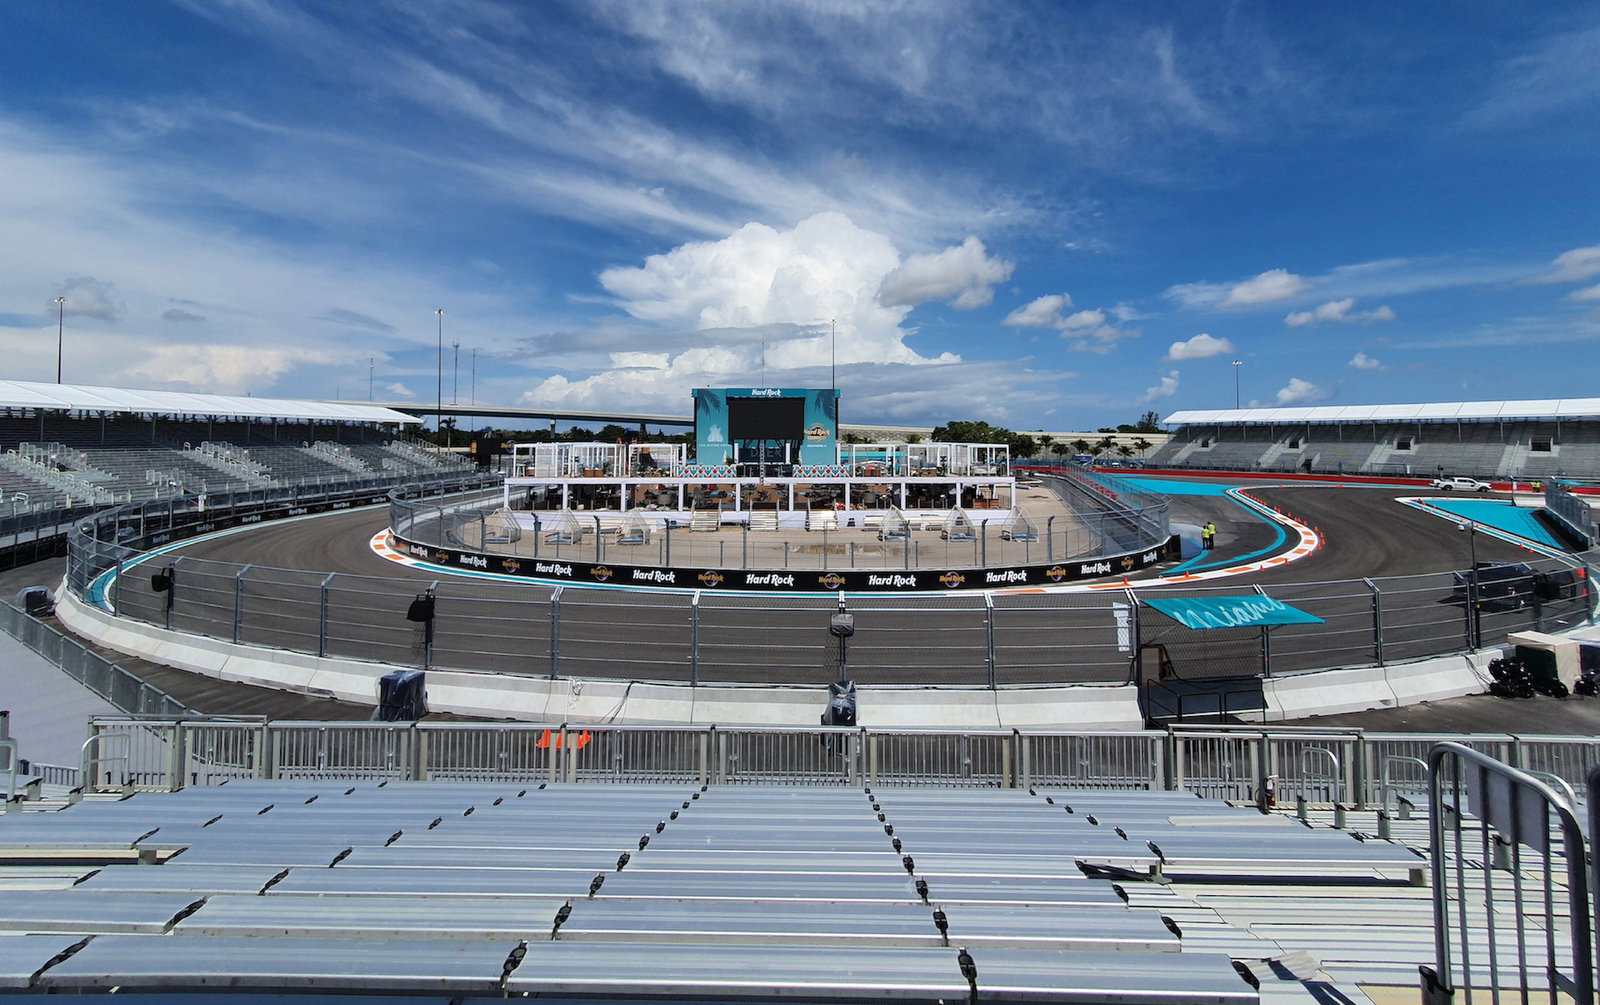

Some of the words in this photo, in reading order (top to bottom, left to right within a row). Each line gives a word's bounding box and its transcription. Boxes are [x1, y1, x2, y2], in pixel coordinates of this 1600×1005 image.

[767, 389, 781, 397] Rock
[751, 449, 782, 458] DER
[460, 555, 473, 564] Hard
[474, 556, 488, 568] Rock
[1081, 563, 1097, 574] Hard
[1097, 561, 1111, 574] Rock
[535, 563, 554, 573] Hard
[554, 564, 572, 576] Rock
[633, 569, 654, 580] Hard
[654, 570, 675, 583] Rock
[986, 570, 1007, 583] Hard
[1007, 569, 1027, 583] Rock
[746, 574, 771, 584] Hard
[771, 574, 795, 586] Rock
[869, 575, 893, 585] Hard
[893, 574, 917, 587] Rock
[1173, 596, 1286, 629] Miami
